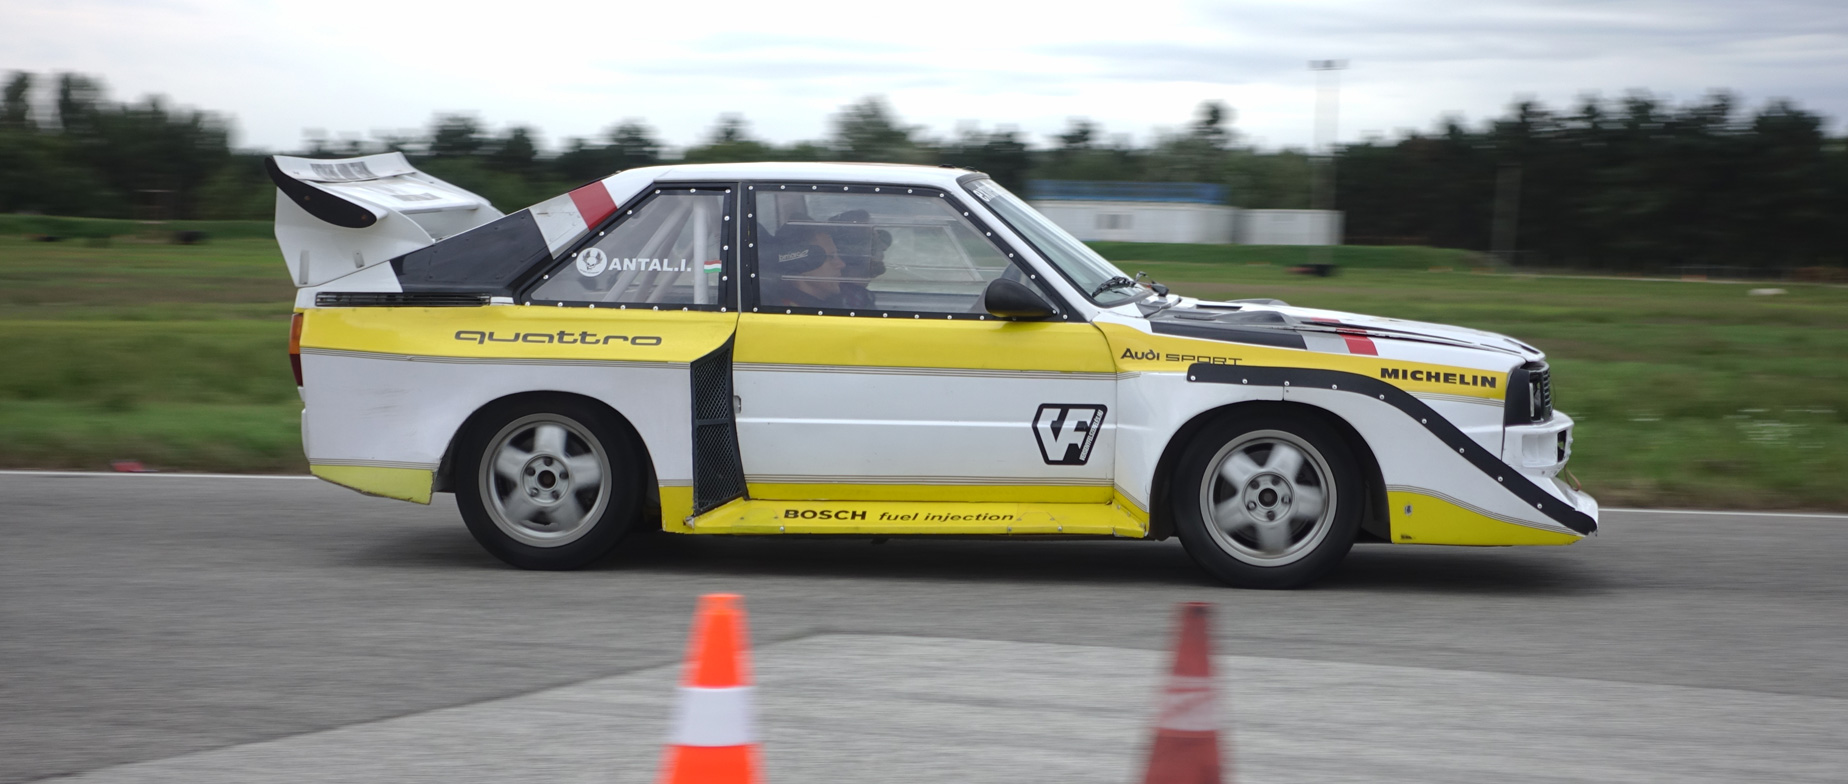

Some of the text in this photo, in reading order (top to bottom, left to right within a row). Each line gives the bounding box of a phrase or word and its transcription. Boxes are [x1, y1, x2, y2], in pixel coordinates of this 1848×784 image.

[454, 330, 662, 346] quattro
[1120, 348, 1243, 366] Audi SPORT
[1380, 367, 1497, 388] MICHELIN
[783, 509, 1014, 523] BOSCH fuel injection
